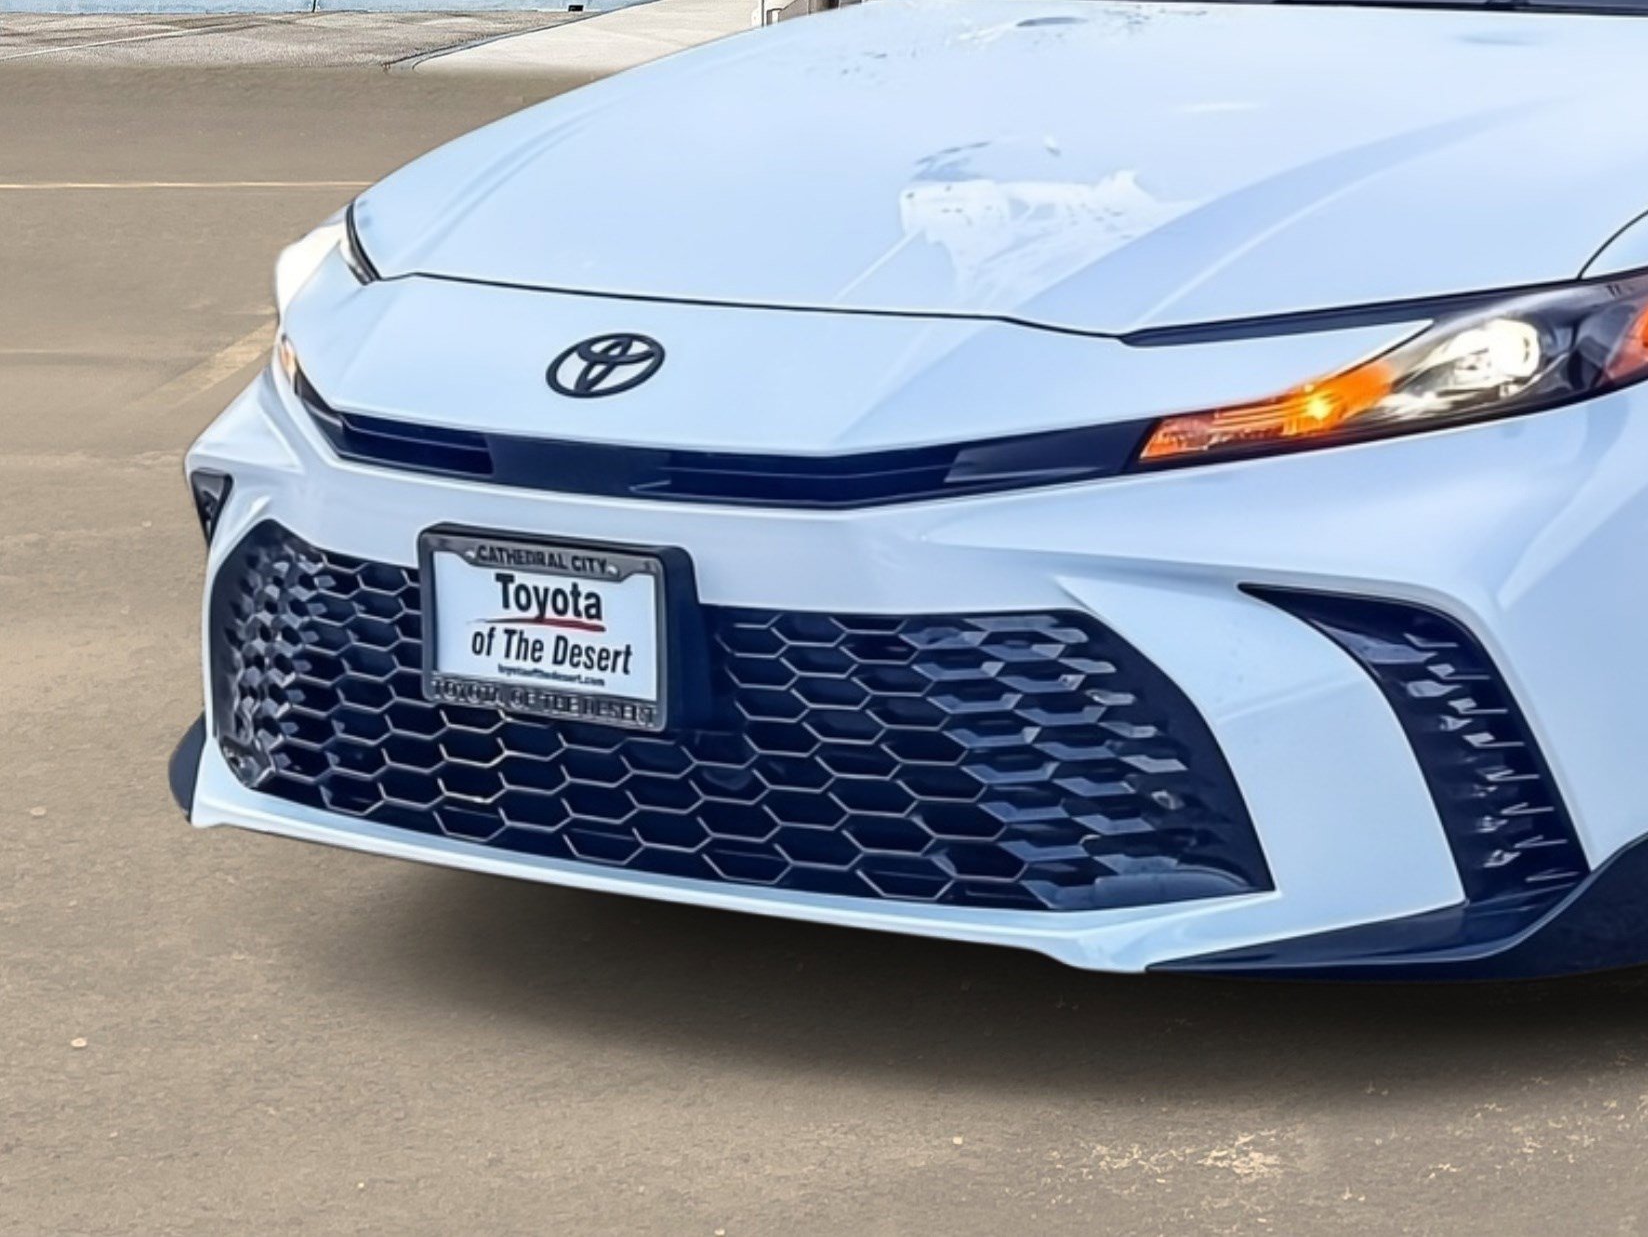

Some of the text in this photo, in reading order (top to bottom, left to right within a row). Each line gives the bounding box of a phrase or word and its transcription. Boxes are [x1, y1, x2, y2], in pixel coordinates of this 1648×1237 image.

[476, 544, 607, 574] CATHEDRAL CITY
[495, 573, 603, 622] Toyota
[471, 626, 632, 675] of The Desert
